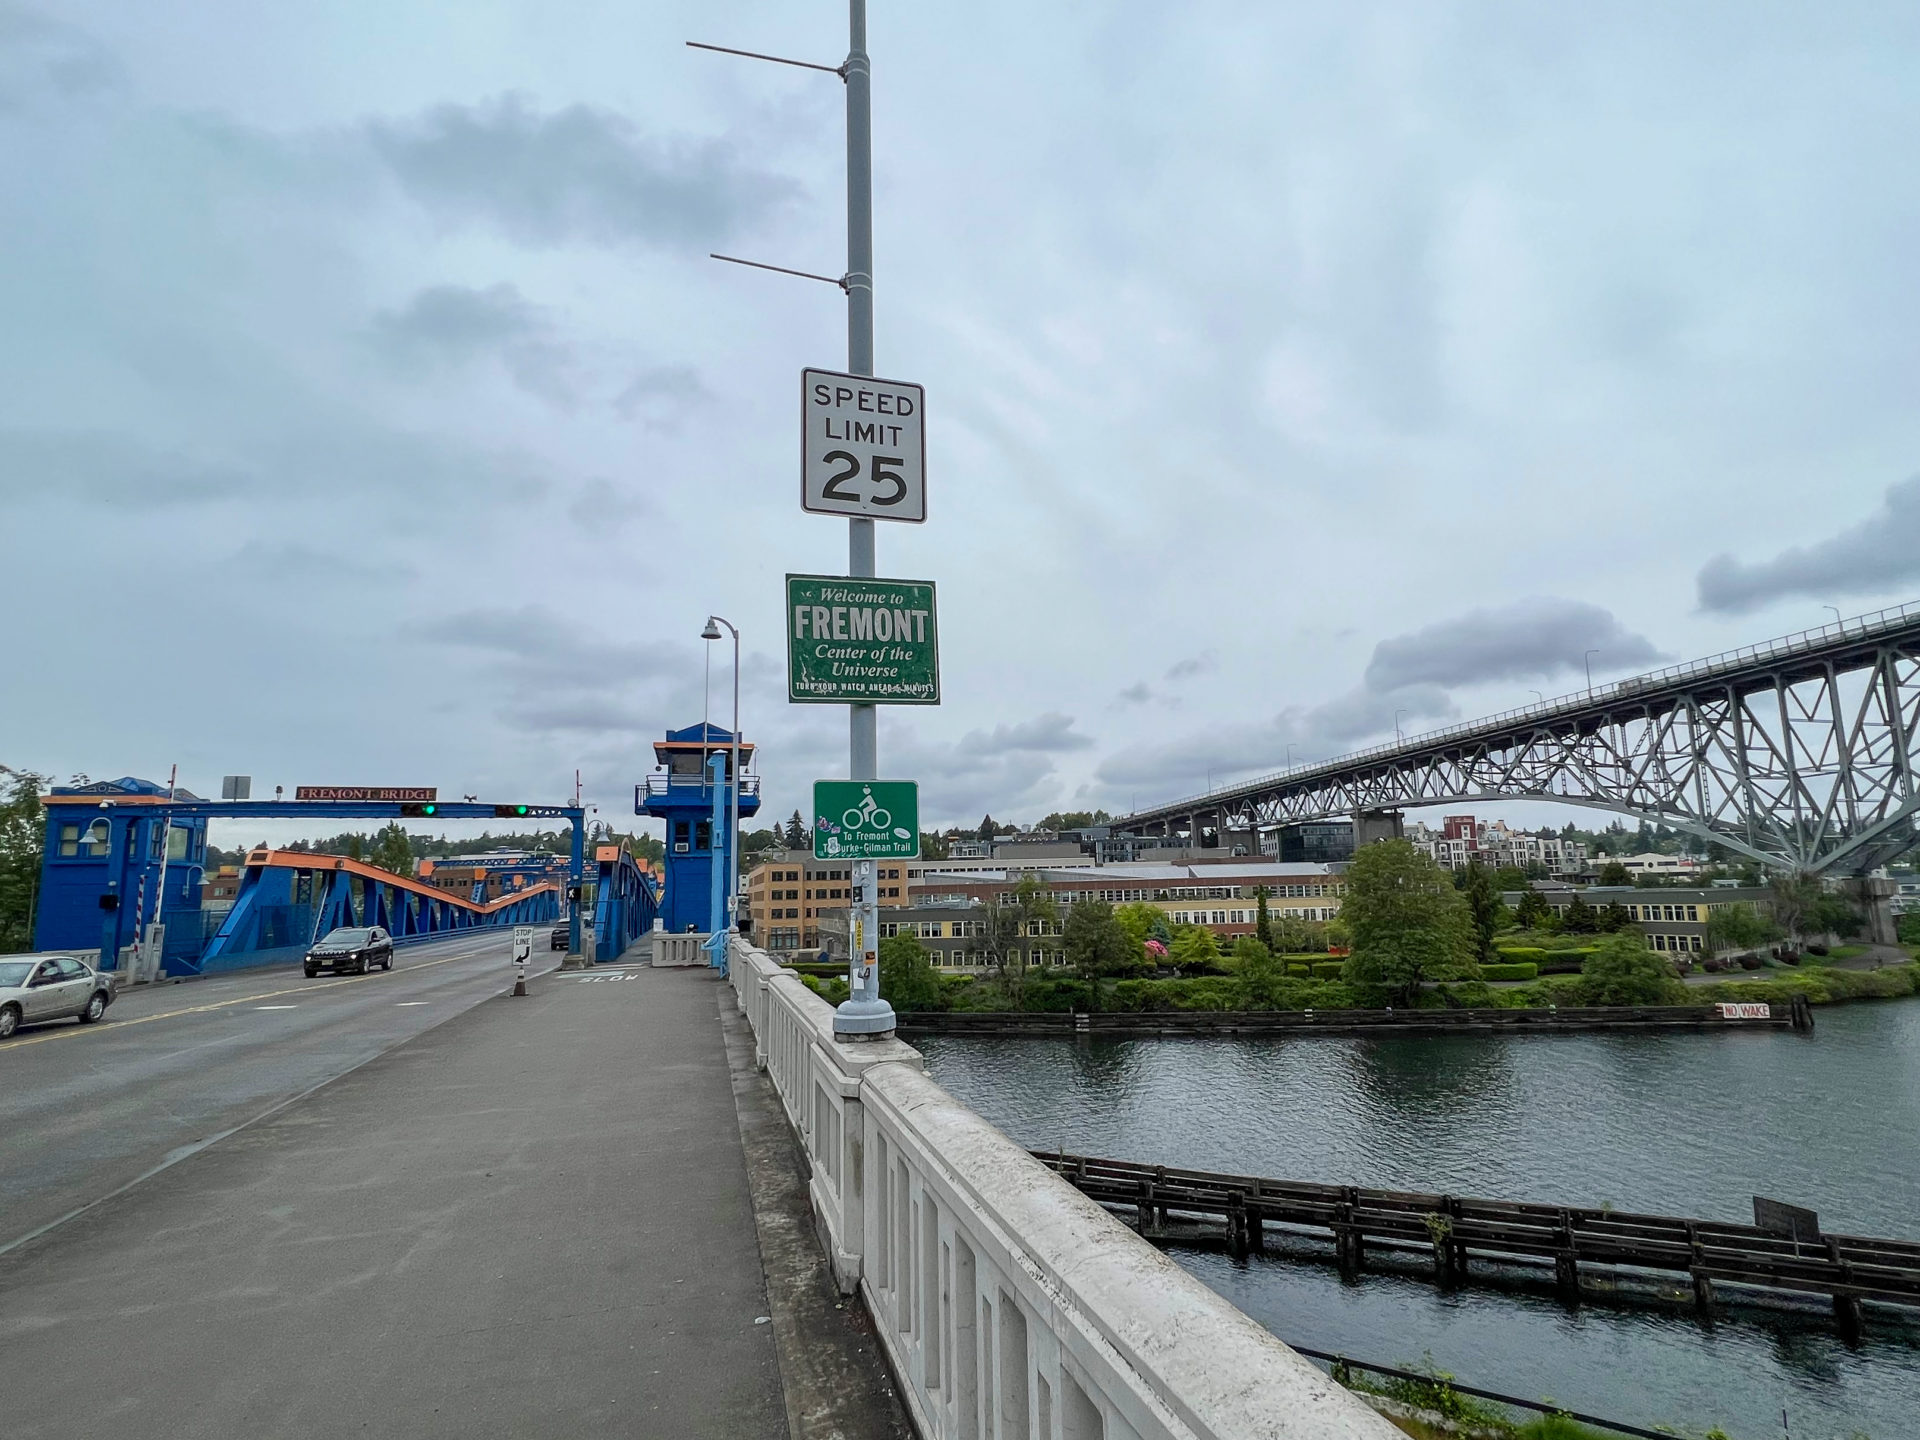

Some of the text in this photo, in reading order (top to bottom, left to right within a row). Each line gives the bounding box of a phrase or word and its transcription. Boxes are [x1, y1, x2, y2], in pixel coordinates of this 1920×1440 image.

[814, 384, 914, 416] SPEED
[825, 417, 903, 446] LIMIT
[822, 450, 907, 506] 25
[821, 588, 904, 604] Welcome to
[795, 605, 929, 643] FREMONT
[815, 644, 913, 663] Center of the
[831, 662, 898, 677] Universe
[796, 682, 818, 690] TURN
[819, 682, 838, 691] YOUR
[841, 683, 865, 692] WATCH
[869, 683, 892, 692] AHEAD
[904, 683, 934, 693] MINUTES
[300, 788, 433, 800] FREMONT BRIDGE
[843, 831, 890, 841] To Fremont
[838, 842, 891, 852] Burke-Gilman
[893, 842, 911, 852] Trail
[515, 938, 531, 946] LINE
[577, 974, 639, 984] SLOW
[1724, 1005, 1769, 1017] NO WAKE
